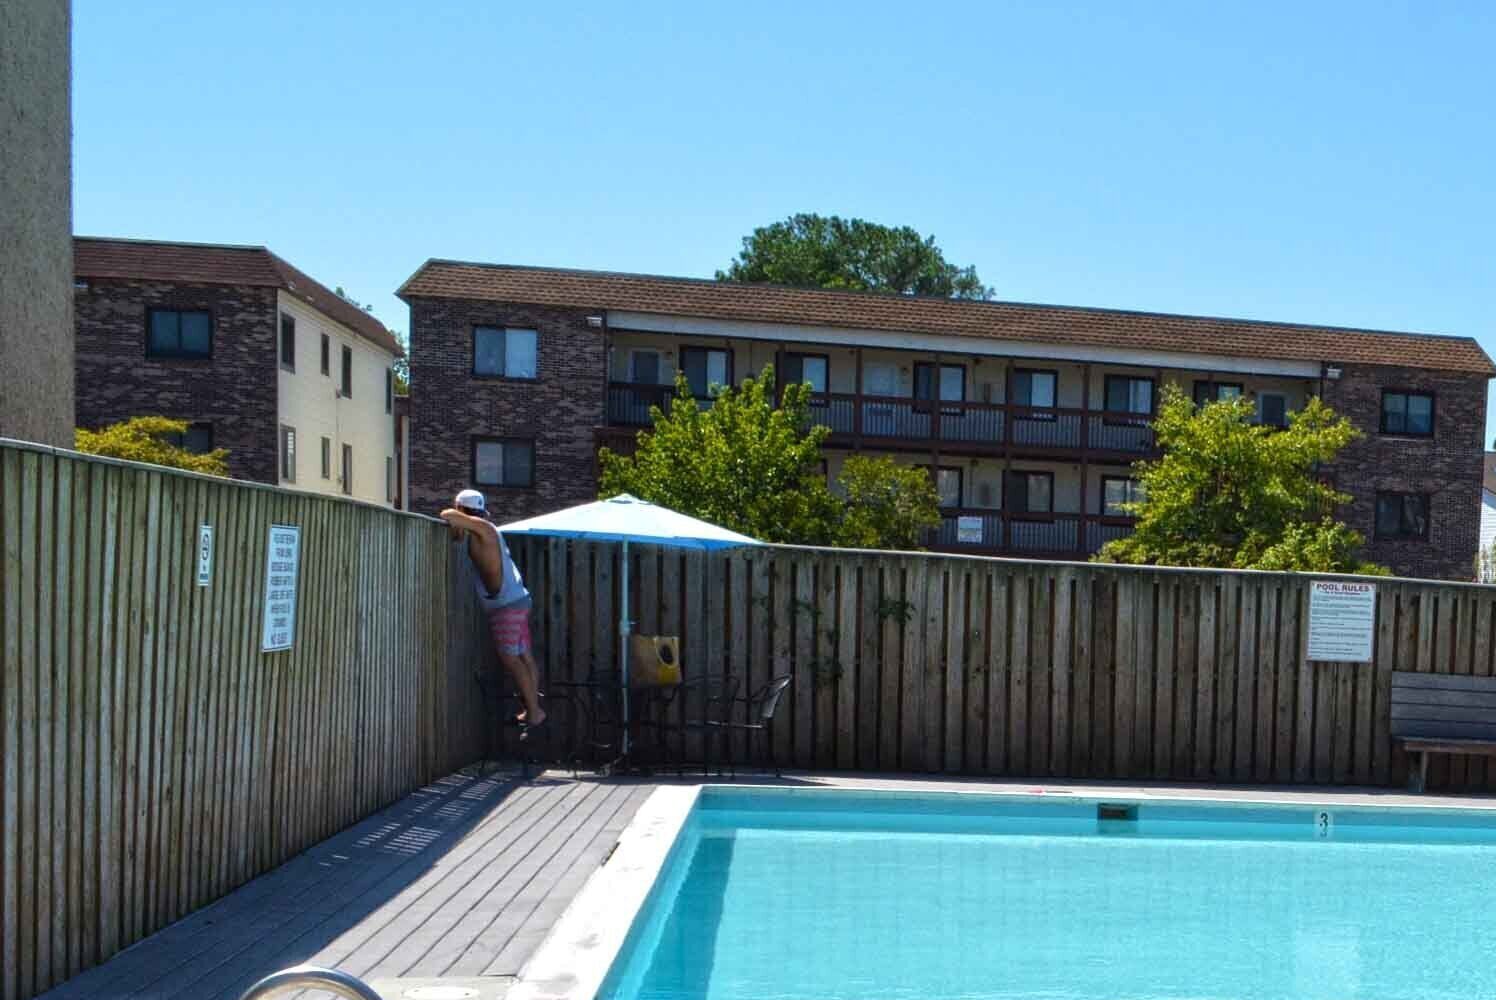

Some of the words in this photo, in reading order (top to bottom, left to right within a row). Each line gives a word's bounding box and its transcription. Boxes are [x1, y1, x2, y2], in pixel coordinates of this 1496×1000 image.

[1316, 583, 1341, 592] POOL
[1342, 584, 1370, 592] RULES
[1319, 812, 1328, 834] 3
